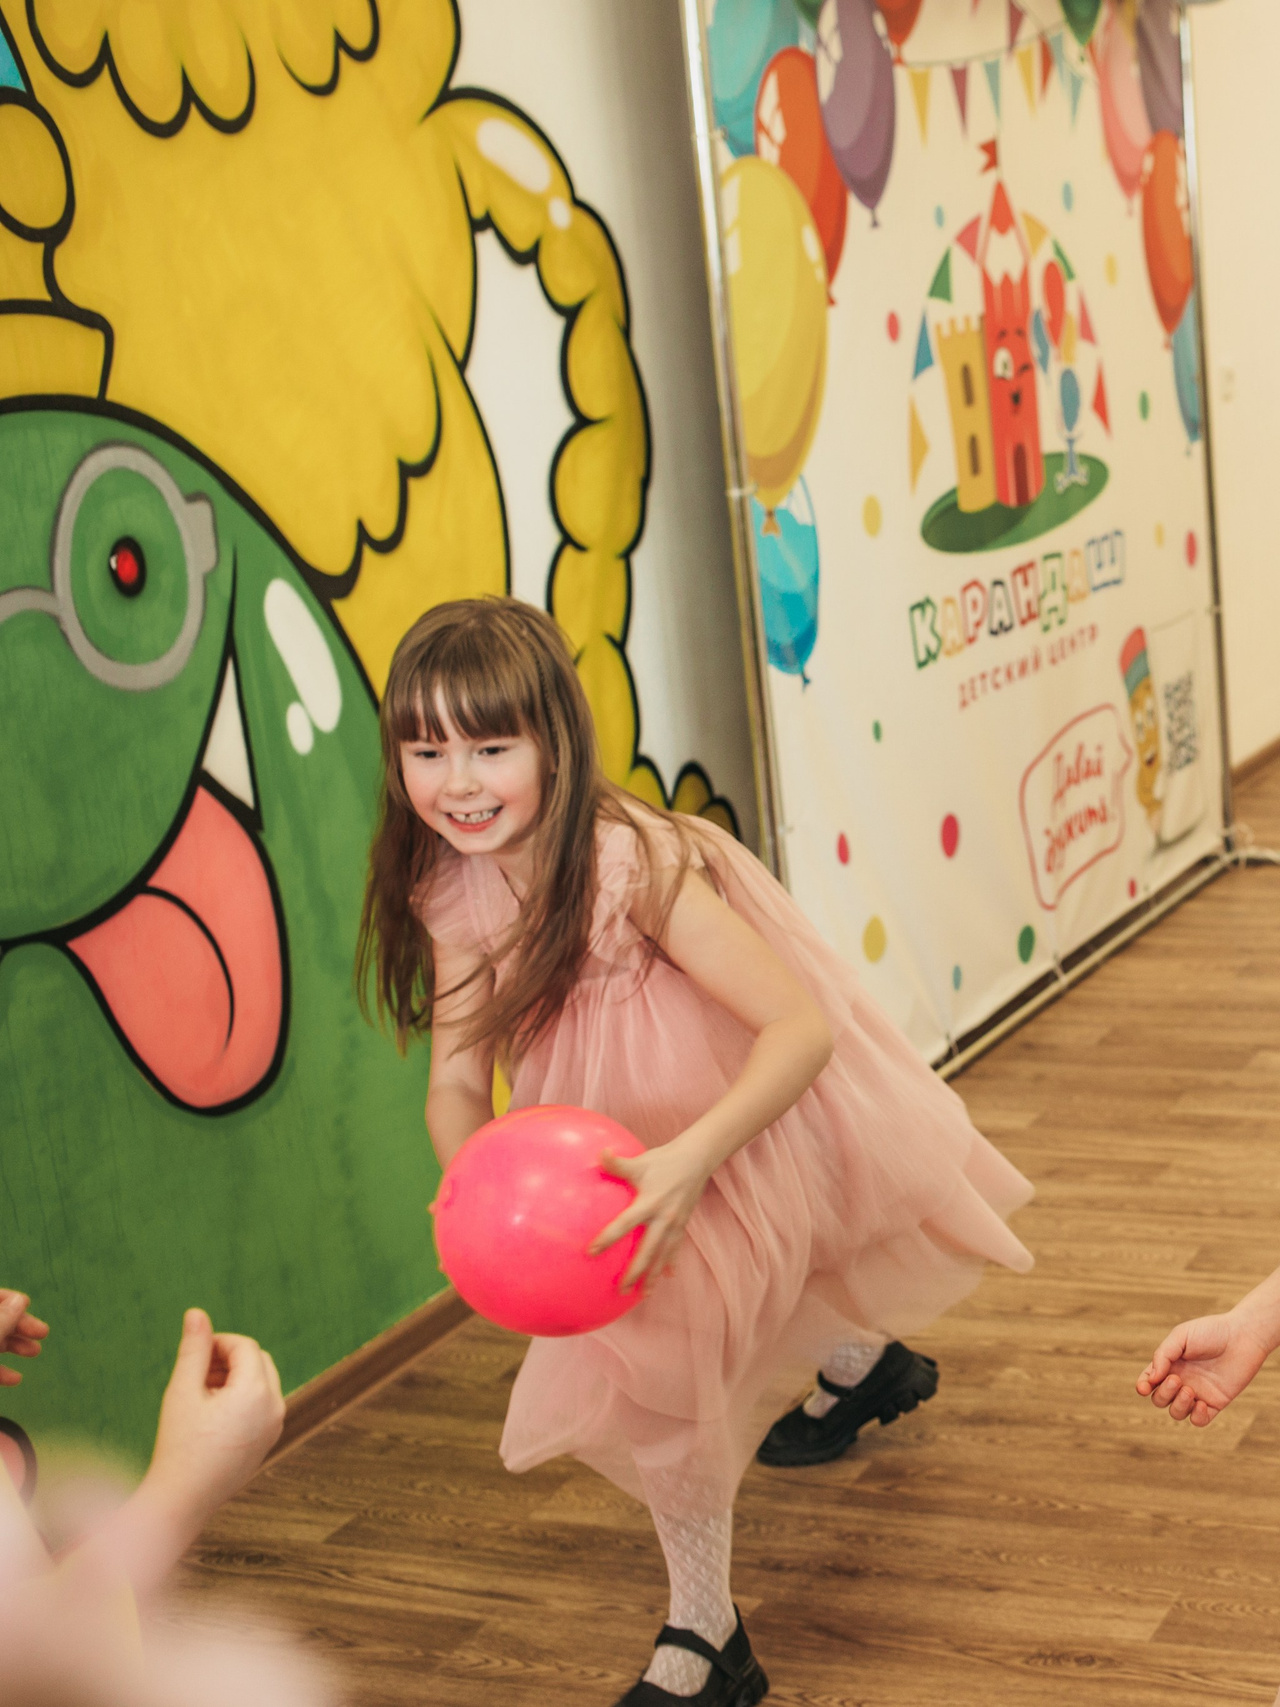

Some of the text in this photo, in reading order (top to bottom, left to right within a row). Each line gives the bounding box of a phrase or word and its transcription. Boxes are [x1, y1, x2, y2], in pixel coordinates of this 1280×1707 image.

[909, 529, 1126, 671] КАРАНДАШ
[958, 621, 1099, 711] ДЕТСКИЙ ЦЕНТР
